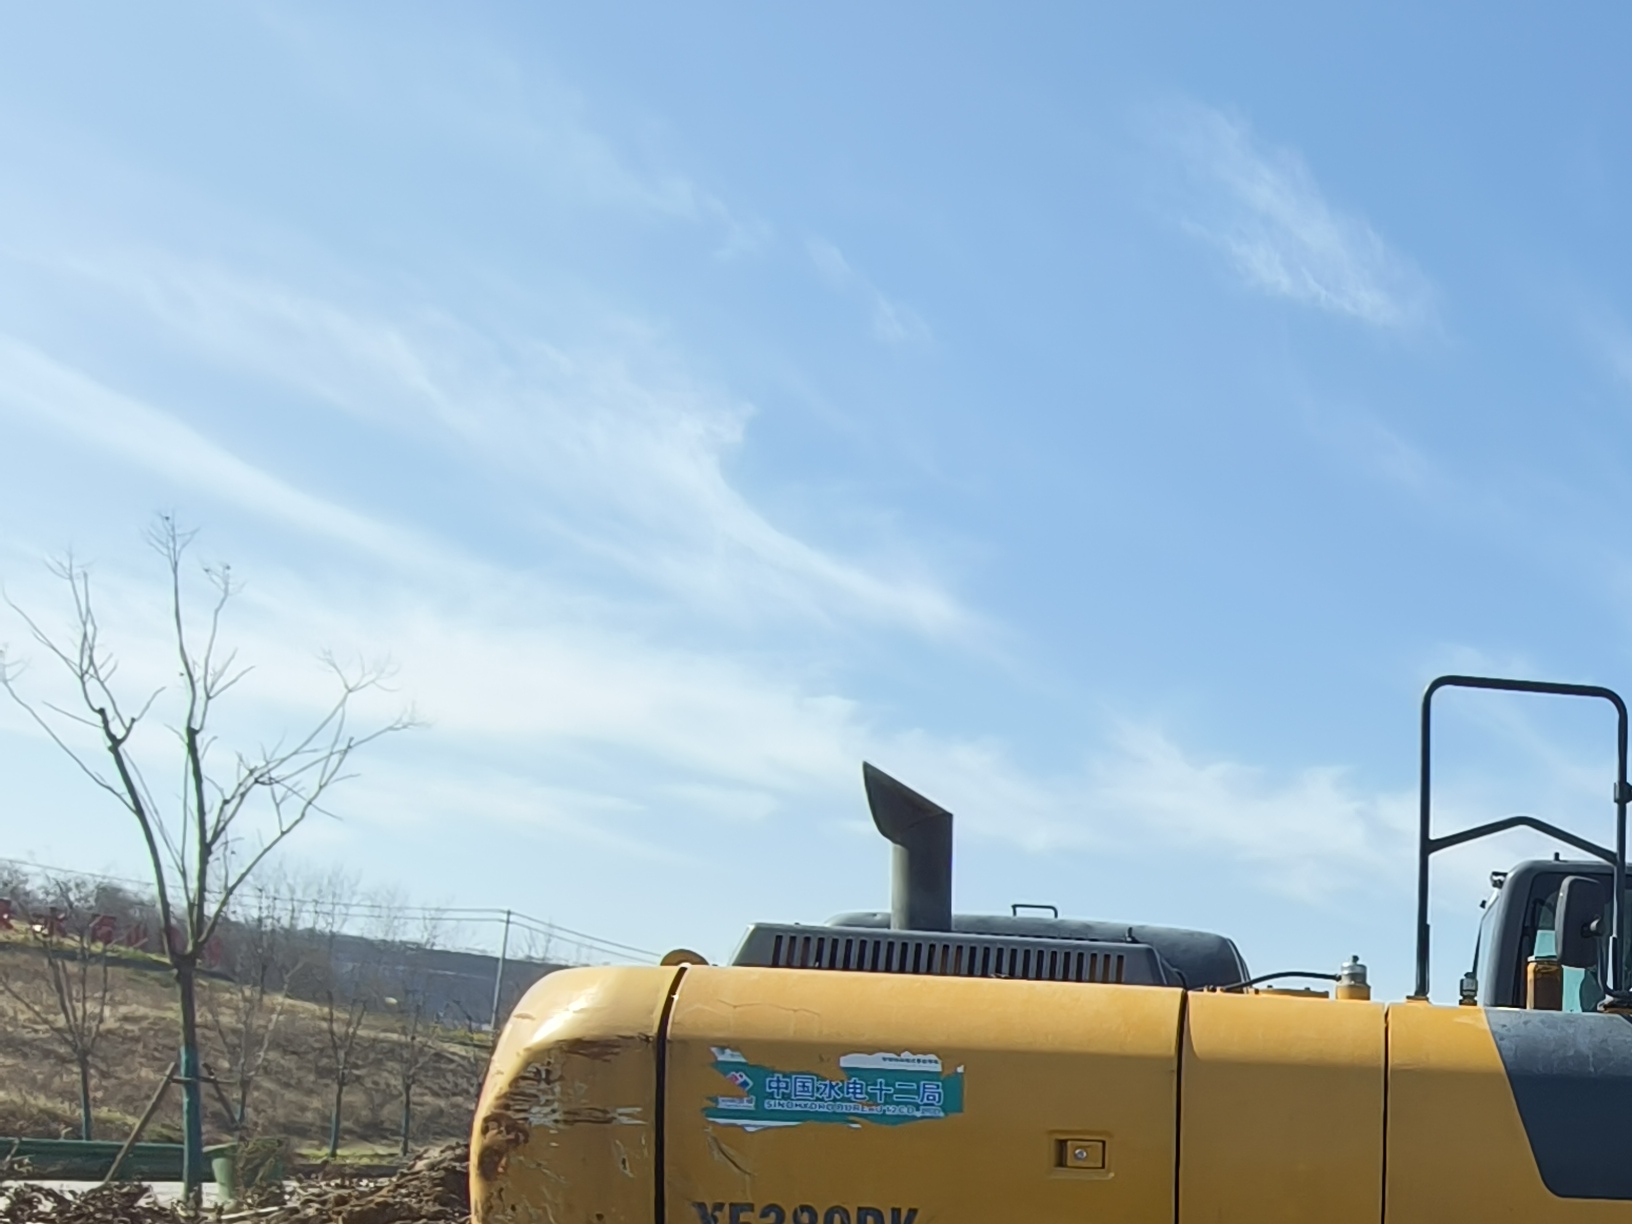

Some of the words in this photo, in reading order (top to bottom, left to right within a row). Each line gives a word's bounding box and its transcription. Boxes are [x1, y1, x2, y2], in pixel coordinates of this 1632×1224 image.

[766, 1074, 944, 1106] 中国水电十二局
